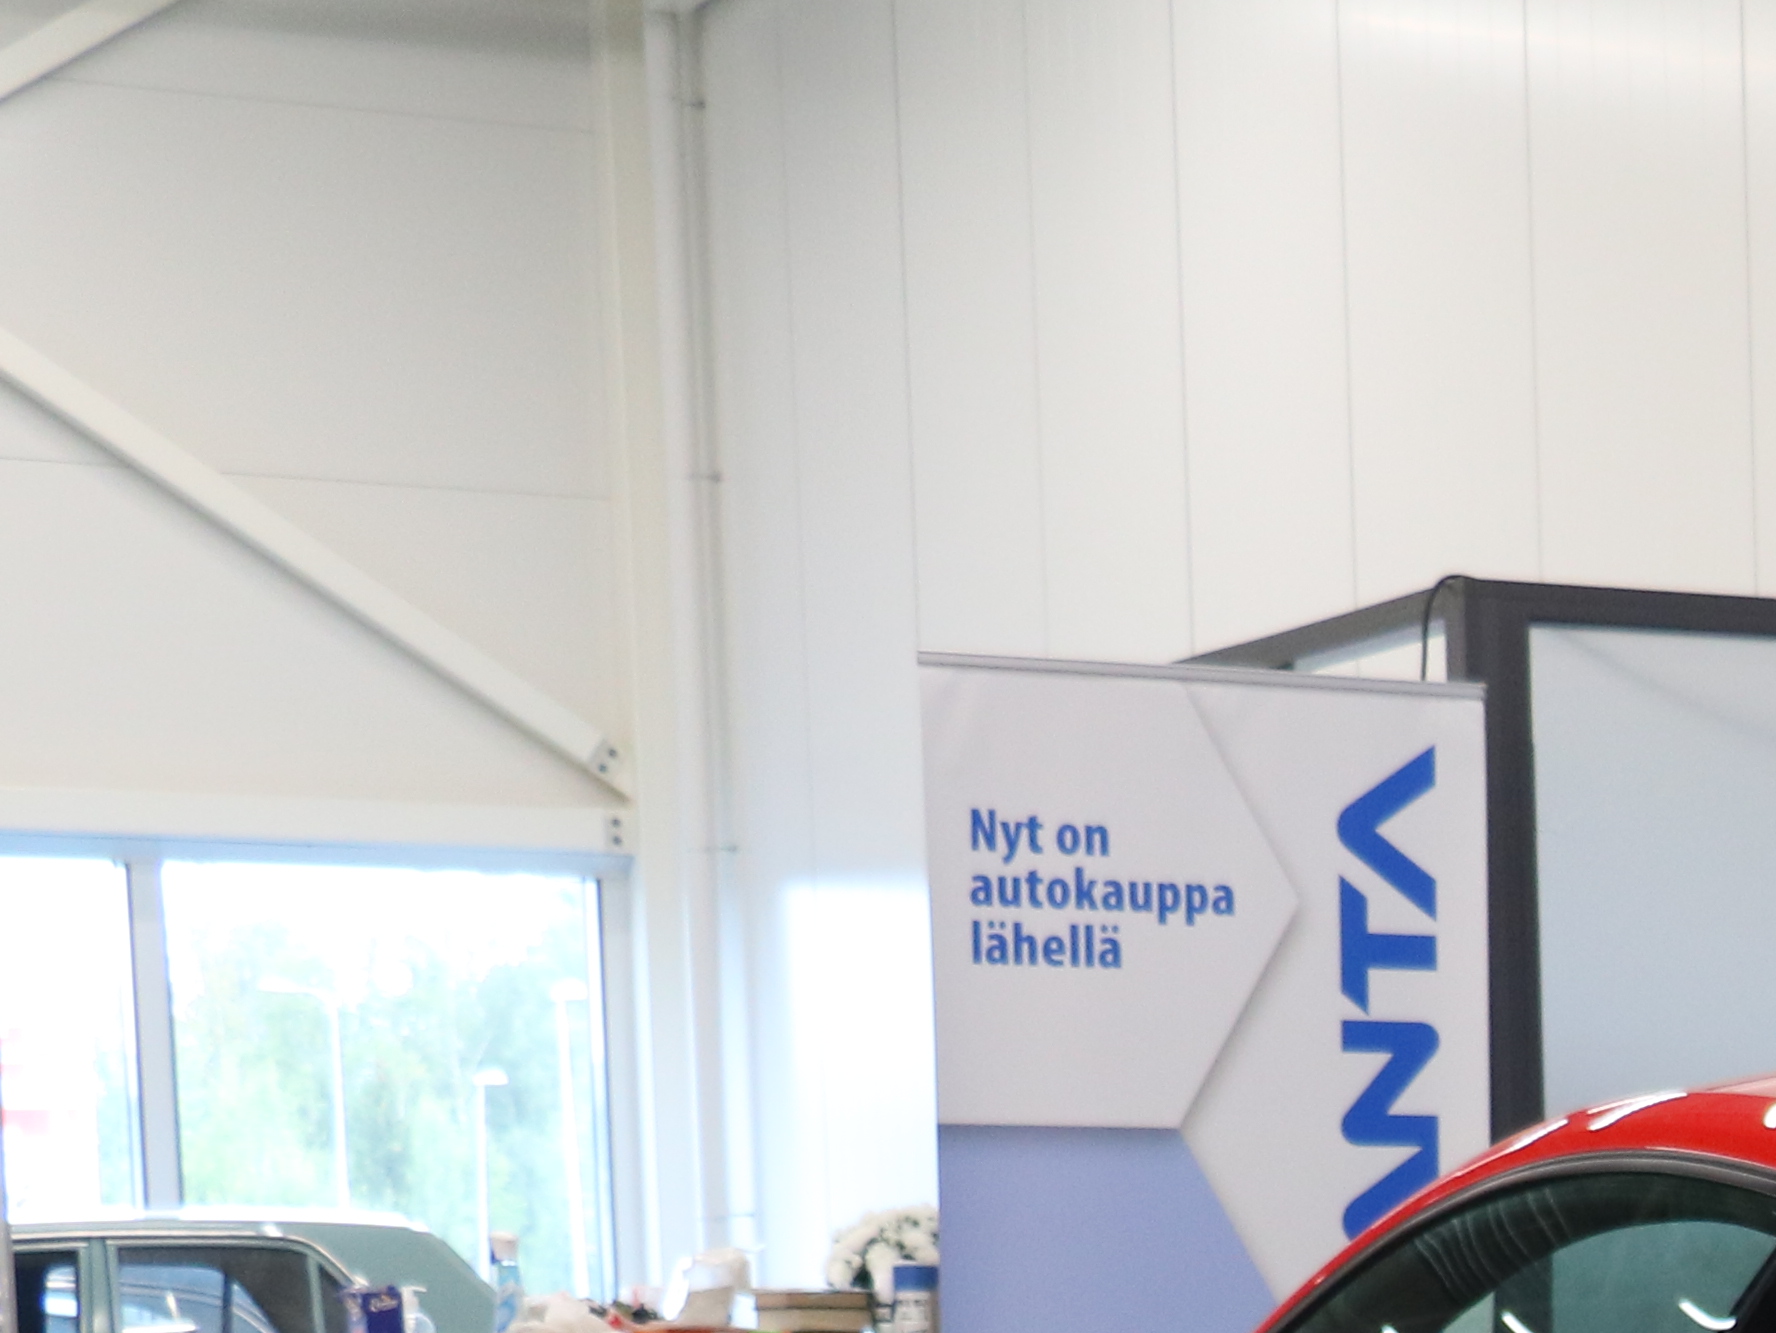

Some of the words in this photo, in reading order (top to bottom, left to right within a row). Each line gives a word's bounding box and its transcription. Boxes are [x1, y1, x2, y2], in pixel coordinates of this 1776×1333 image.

[969, 807, 1043, 864] Nyt
[1056, 816, 1110, 857] on
[969, 866, 1236, 925] autokauppa
[970, 920, 1123, 970] lähellä
[1336, 743, 1441, 1243] ANTA
